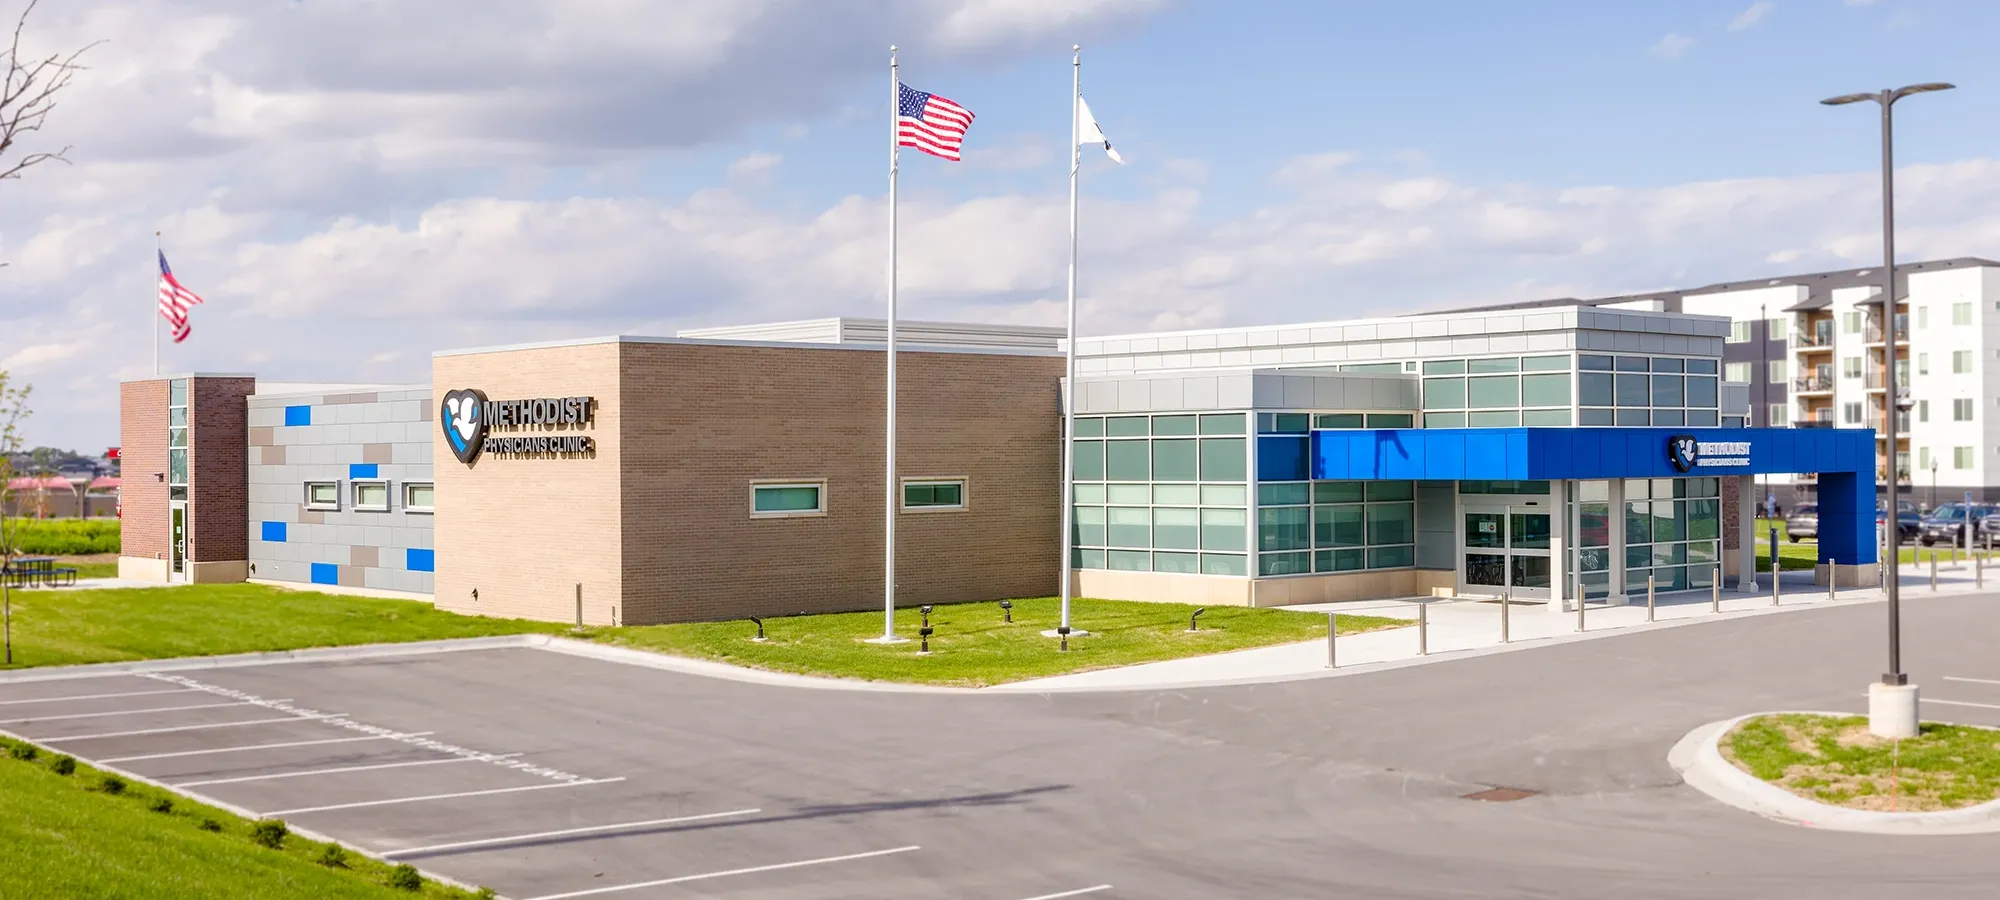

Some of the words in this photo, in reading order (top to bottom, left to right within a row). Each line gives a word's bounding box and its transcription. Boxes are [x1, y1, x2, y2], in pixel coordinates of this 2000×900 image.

[484, 396, 591, 426] METHODIST
[484, 437, 547, 452] PHYSICIANS
[550, 436, 587, 452] CLINIC
[1697, 442, 1751, 455] METHODIST
